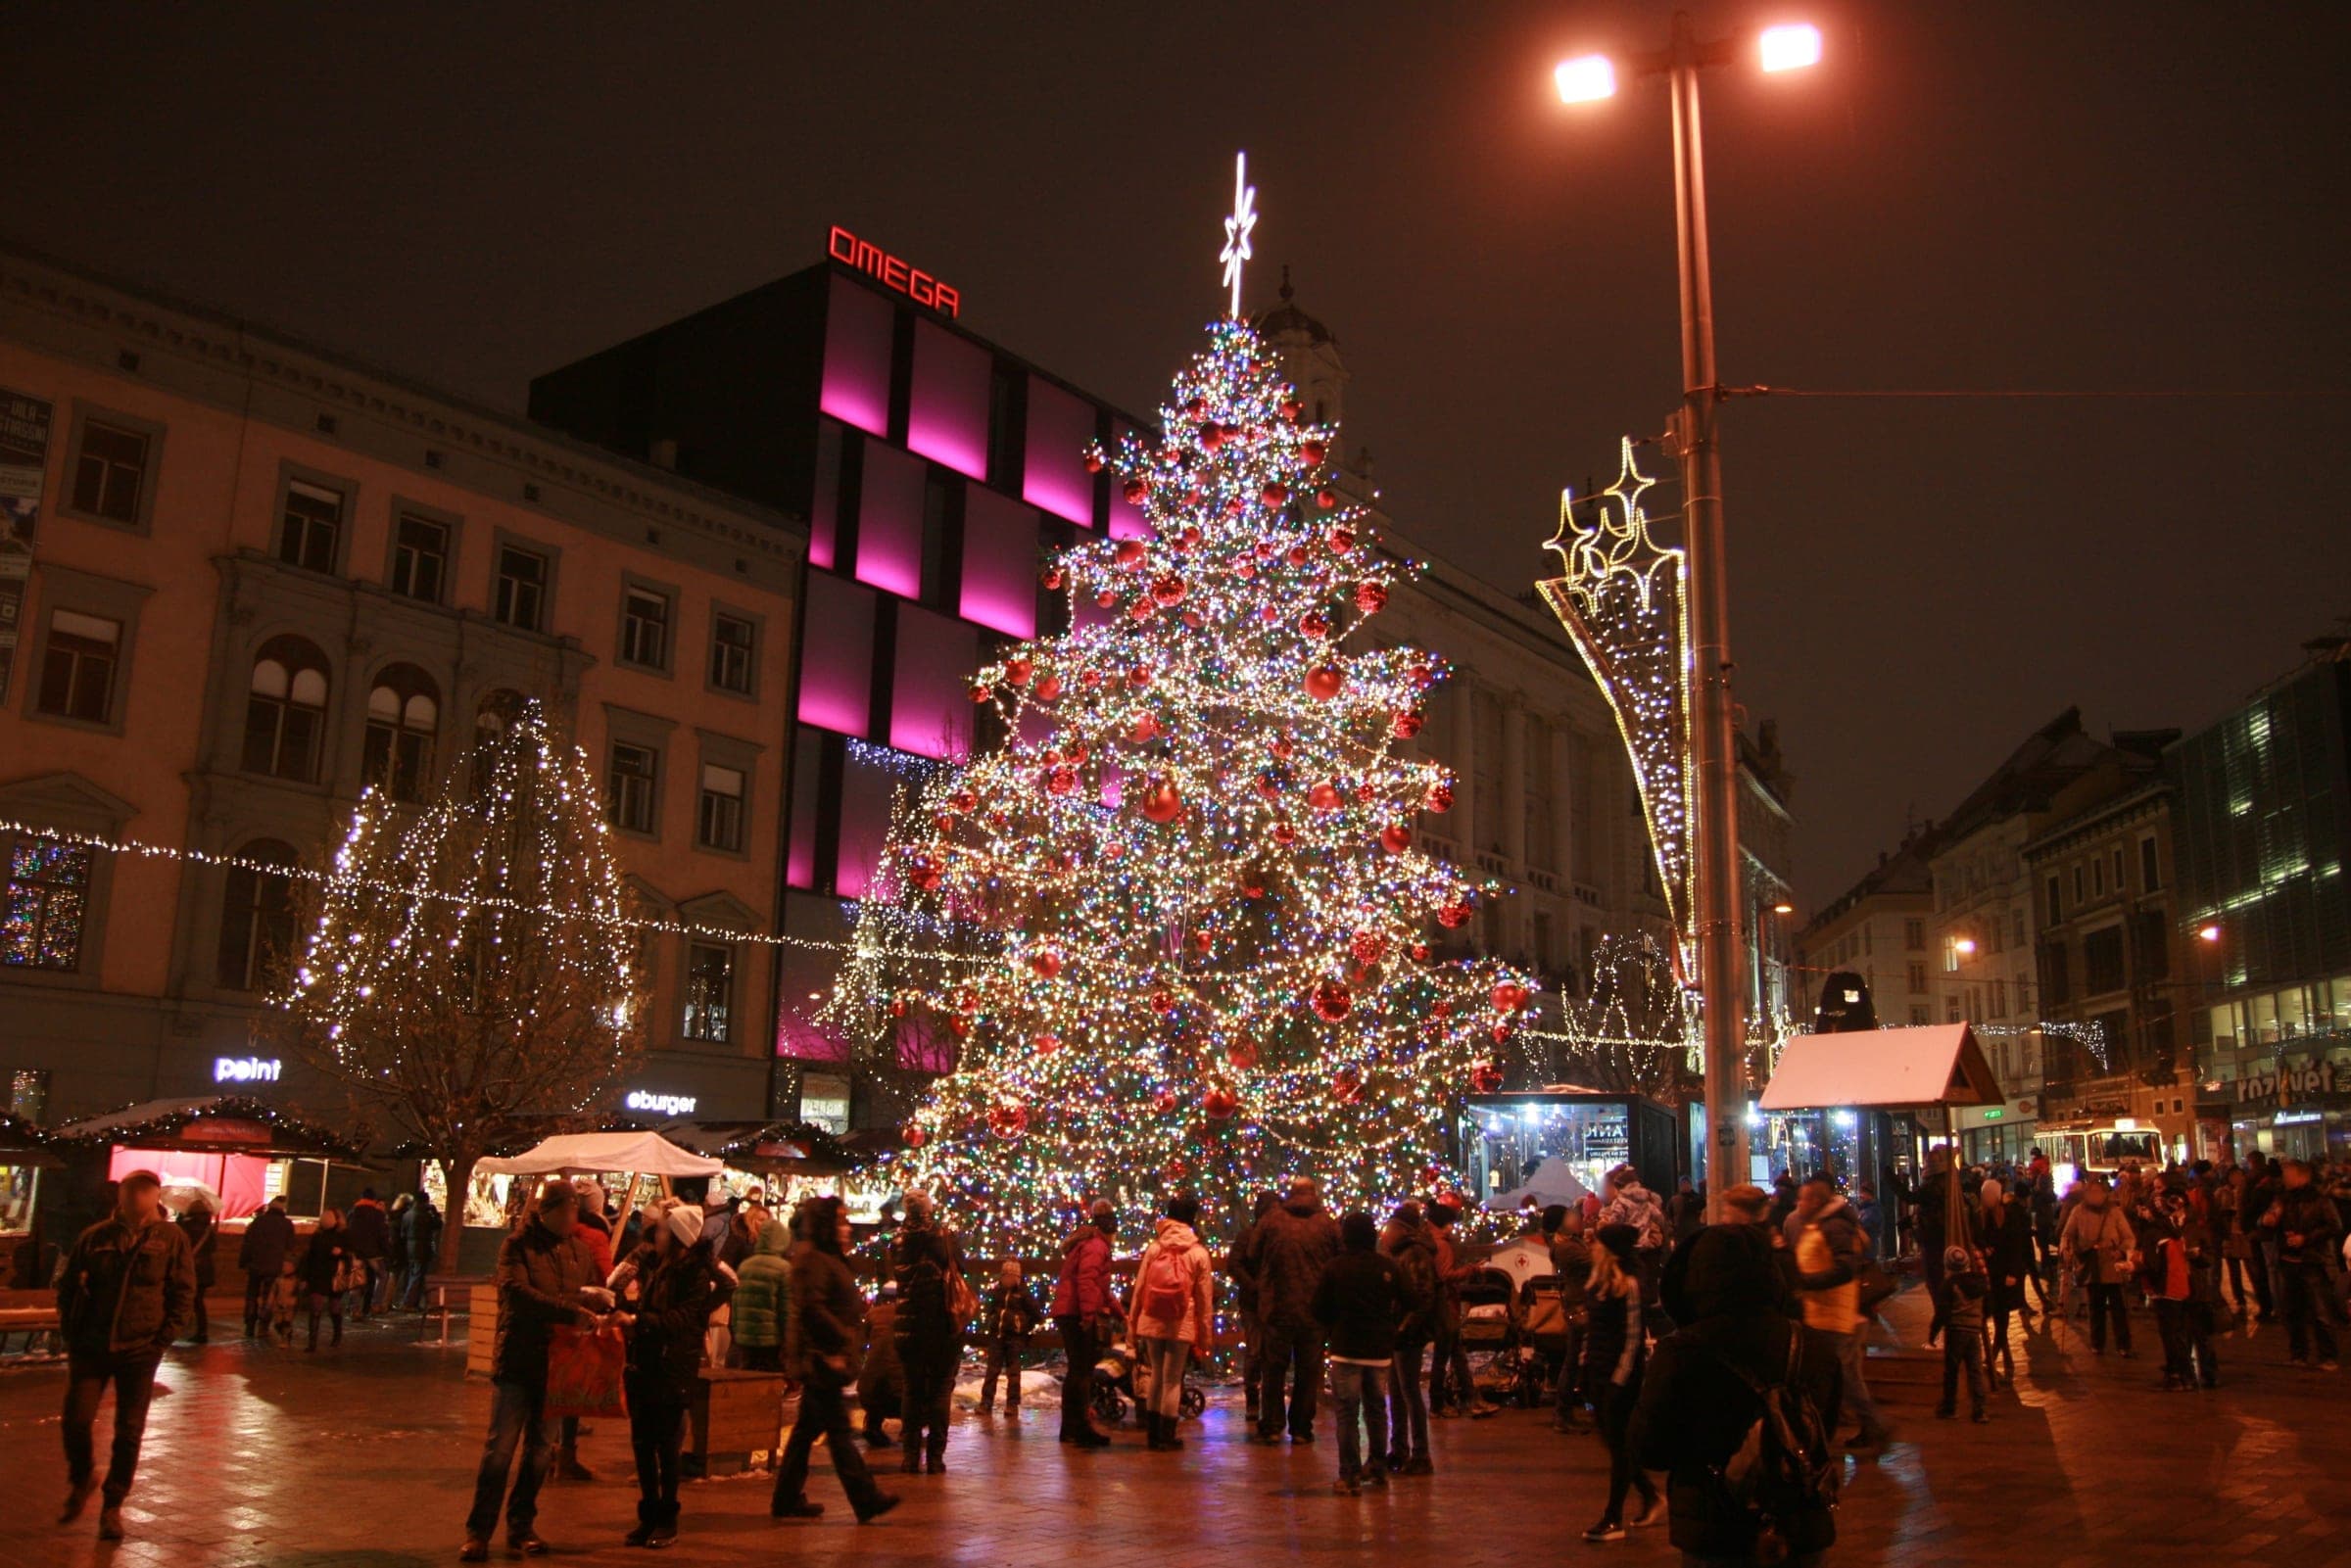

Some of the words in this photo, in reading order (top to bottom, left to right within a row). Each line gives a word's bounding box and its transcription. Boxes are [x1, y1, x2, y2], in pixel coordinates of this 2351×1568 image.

[830, 224, 960, 318] OMEGA
[215, 1057, 282, 1082] point
[626, 1089, 696, 1116] eburger
